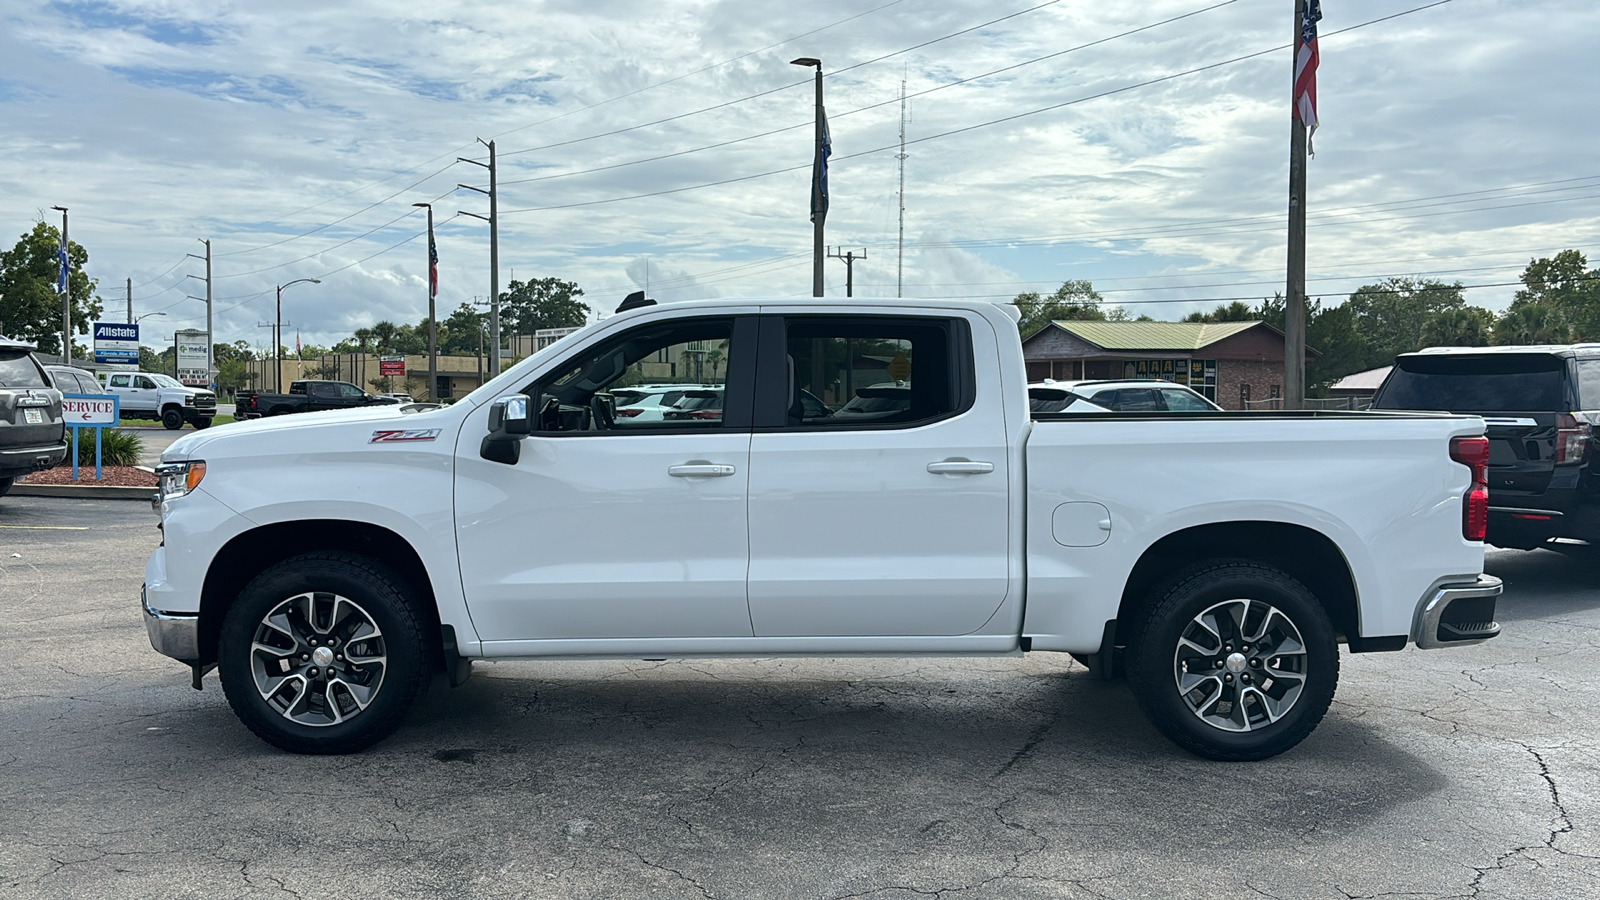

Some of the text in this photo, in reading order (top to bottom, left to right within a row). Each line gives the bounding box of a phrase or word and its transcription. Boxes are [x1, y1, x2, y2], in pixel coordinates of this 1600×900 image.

[96, 326, 136, 337] Allstate
[62, 401, 113, 413] SERVICE
[367, 428, 443, 444] Z71
